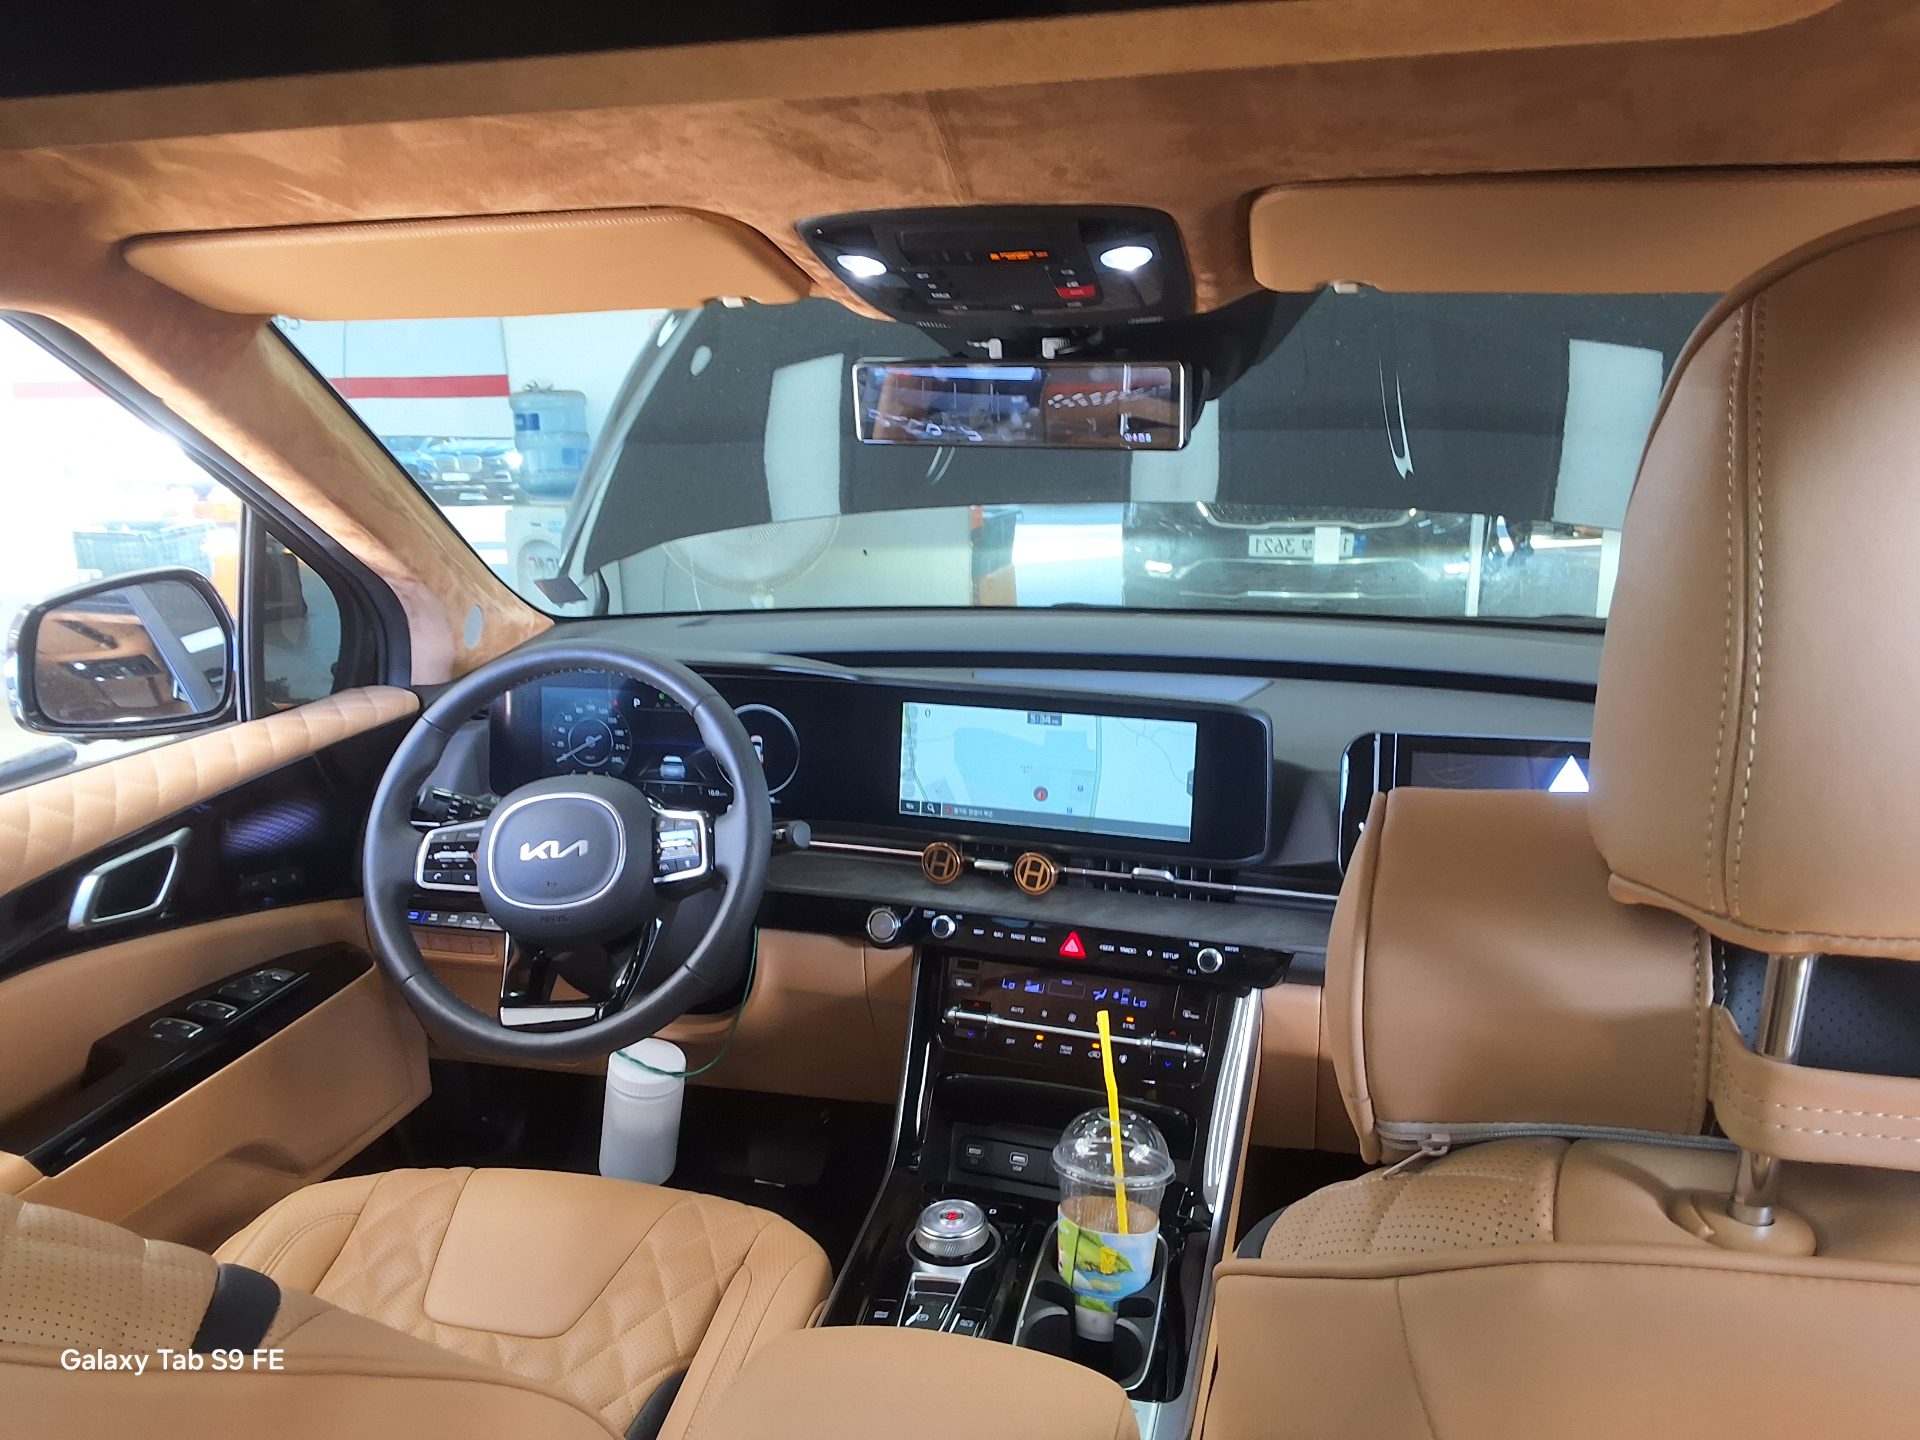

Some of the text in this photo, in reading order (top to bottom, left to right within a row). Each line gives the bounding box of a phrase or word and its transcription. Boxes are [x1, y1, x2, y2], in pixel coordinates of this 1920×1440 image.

[1010, 933, 1026, 941] RADIO
[1030, 935, 1047, 943] MEDIA
[1162, 951, 1180, 960] SETUP
